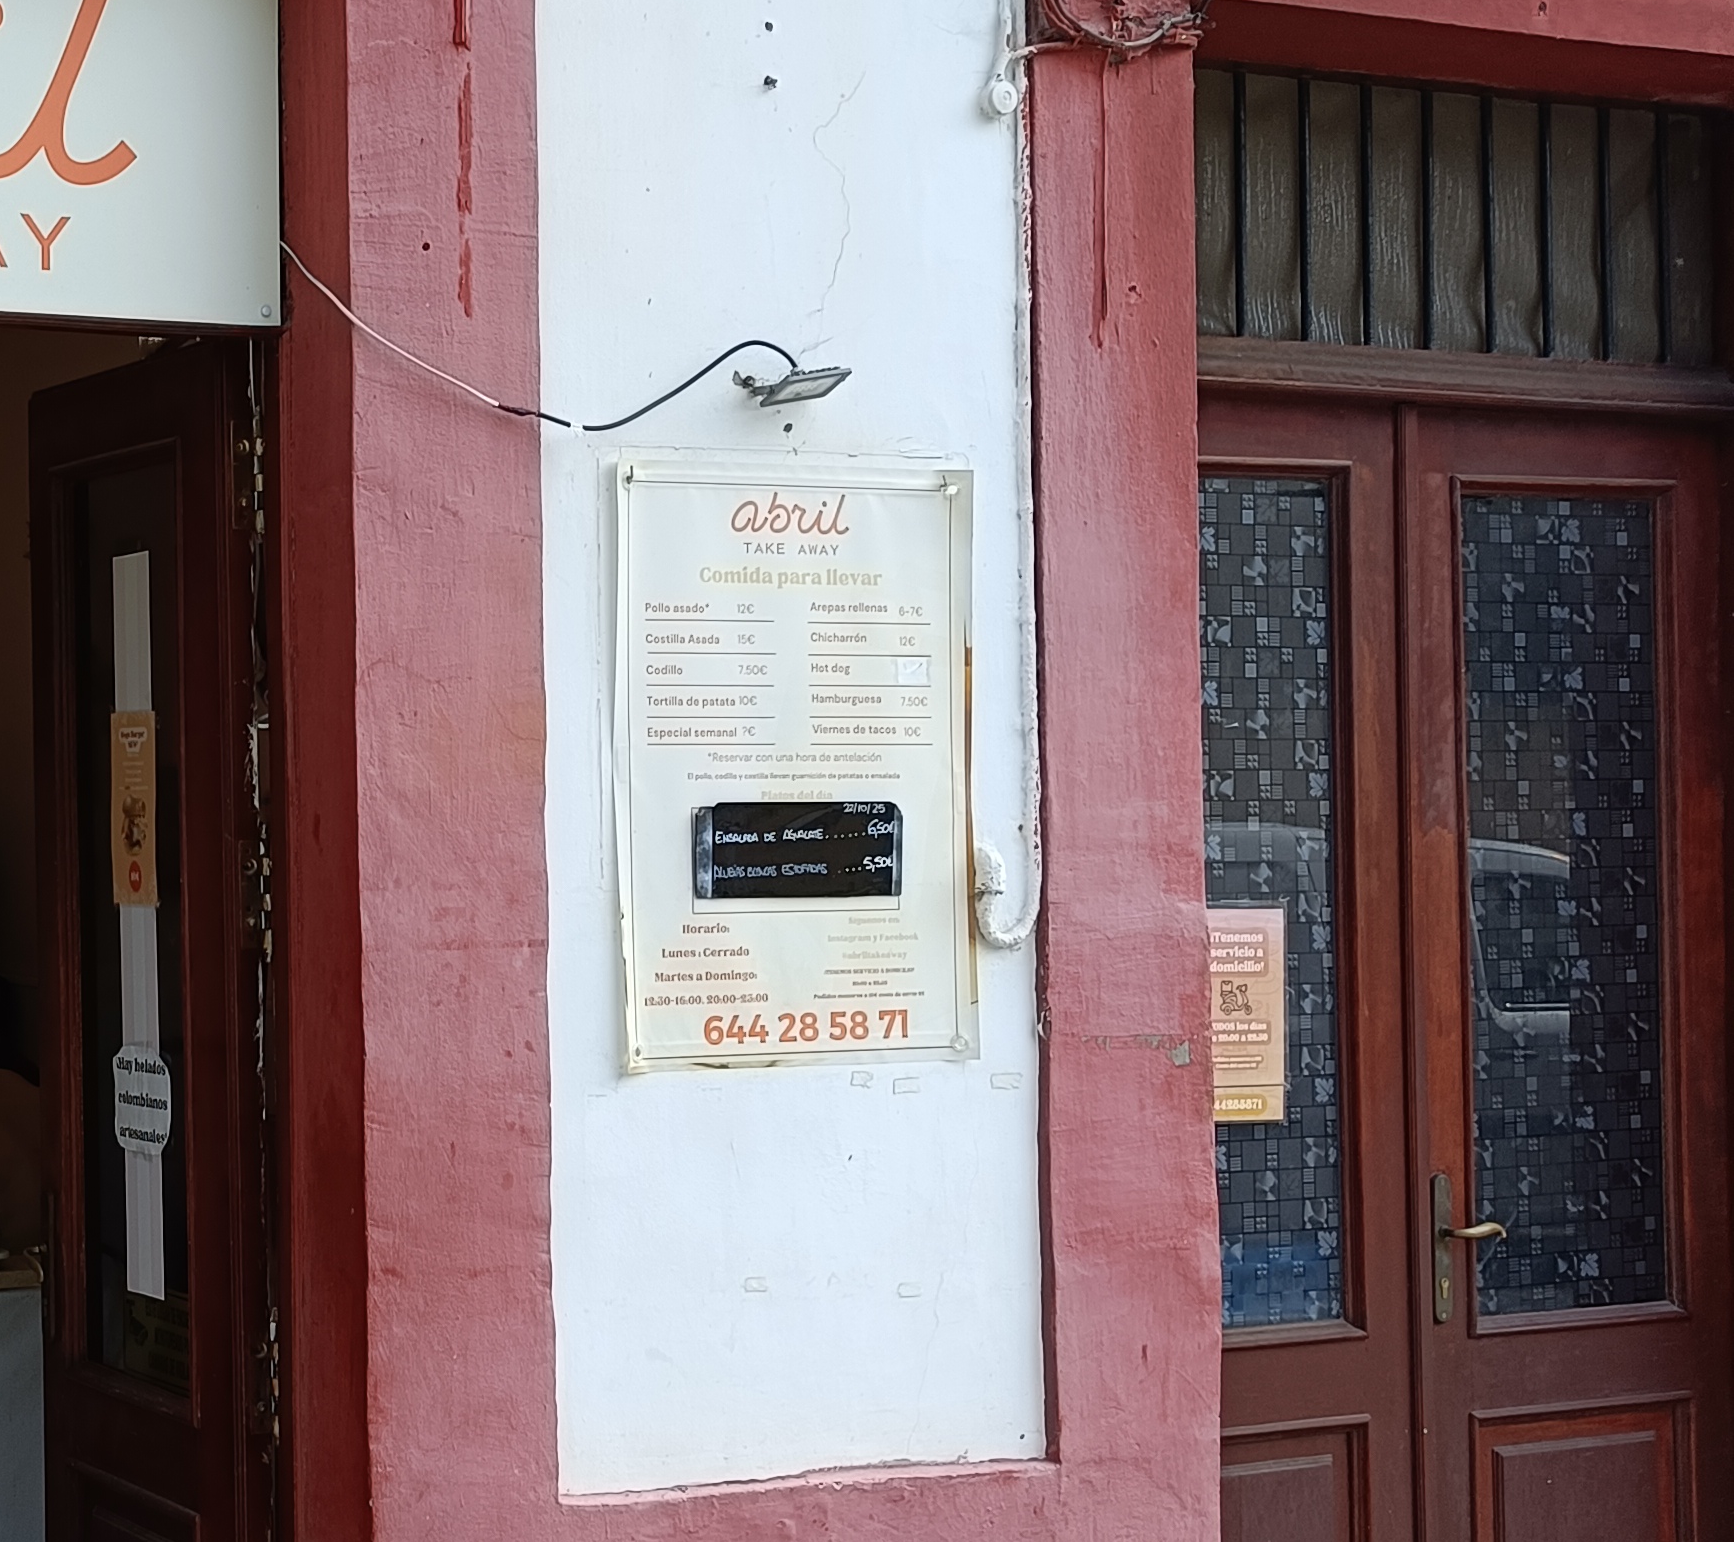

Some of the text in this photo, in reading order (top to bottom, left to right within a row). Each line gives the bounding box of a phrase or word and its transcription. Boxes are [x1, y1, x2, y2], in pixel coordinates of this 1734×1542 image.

[731, 491, 849, 534] abril
[743, 543, 839, 556] TAKE AWAY
[700, 566, 882, 589] Comida para llevar
[645, 603, 670, 613] Pollo
[737, 603, 755, 614] 12€
[810, 602, 923, 617] Arepas rellenas 6-7€
[646, 634, 755, 644] Costilla Asada 15€
[810, 632, 916, 646] Chicharrón 12€
[646, 665, 683, 675] Codillo
[811, 663, 850, 675] Hot dog
[647, 696, 757, 709] Tortilla de patata 10€
[811, 694, 882, 706] Hamburguesa
[648, 727, 691, 739] Especial
[694, 727, 736, 737] semanal
[812, 724, 921, 737] Viernes de tacos 10€
[756, 754, 773, 762] con
[796, 753, 816, 761] hora
[819, 753, 831, 761] de
[834, 753, 882, 761] antelación
[843, 803, 886, 814] 22/10/25
[764, 832, 776, 842] DE
[828, 934, 871, 943] Instagram
[880, 933, 918, 941] Facebook
[662, 949, 696, 958] Lunes
[703, 946, 749, 957] Cerrado
[1210, 946, 1263, 957] servicio a
[1210, 961, 1264, 972] domicilio!
[655, 972, 694, 982] Martes
[704, 1009, 908, 1045] 644 28 58 71
[1237, 1022, 1248, 1030] los
[134, 1058, 166, 1076] helados
[118, 1090, 168, 1110] colombianos
[1214, 1099, 1262, 1109] 44285871
